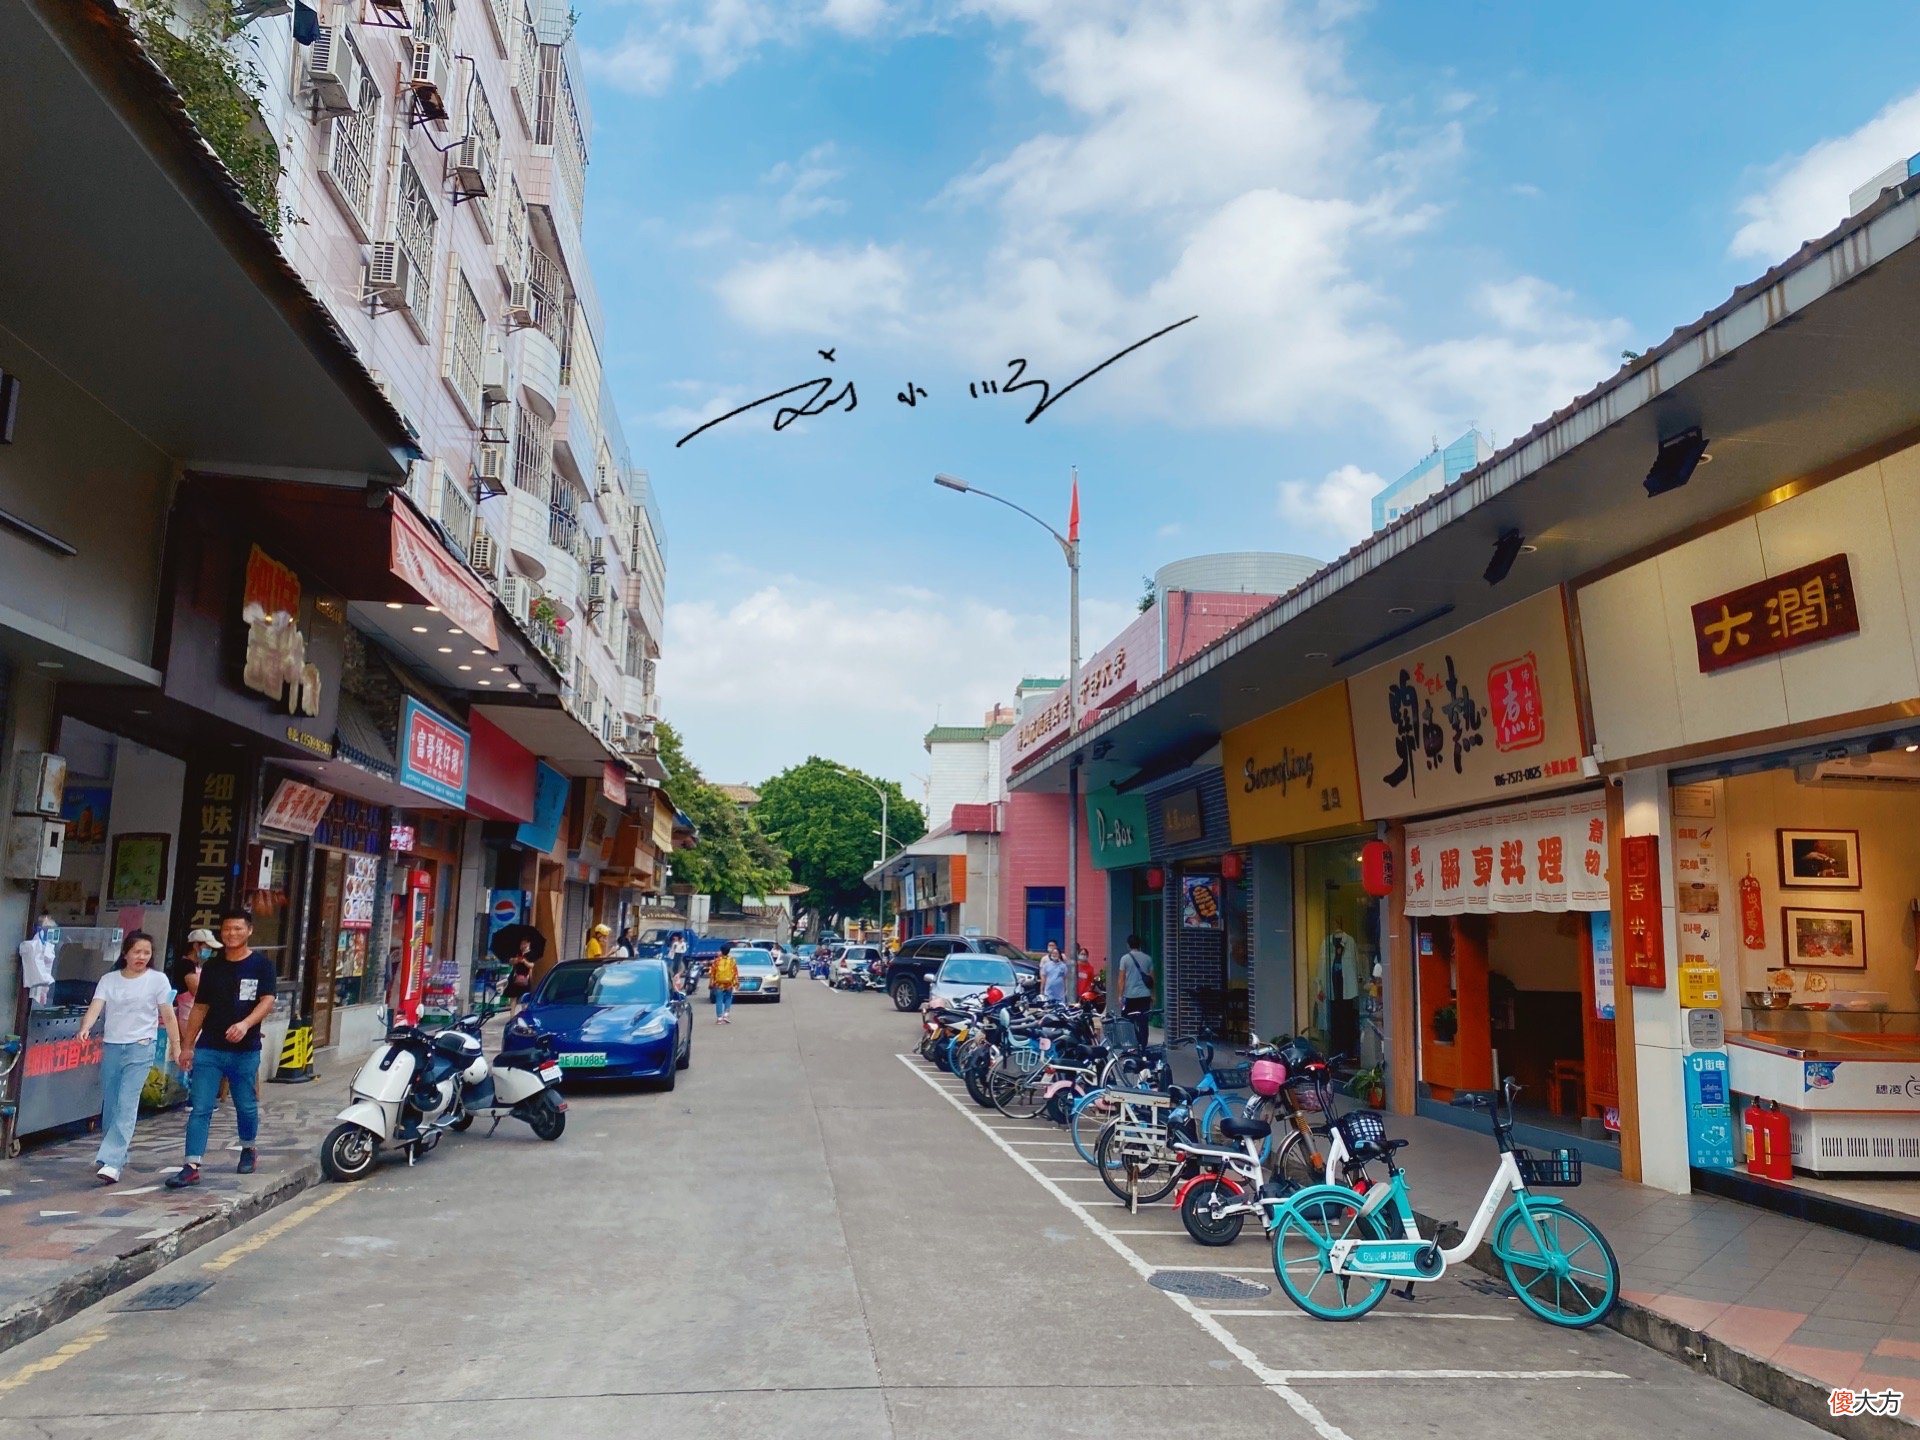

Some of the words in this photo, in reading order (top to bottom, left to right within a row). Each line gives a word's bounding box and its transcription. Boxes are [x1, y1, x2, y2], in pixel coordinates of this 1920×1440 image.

[1439, 835, 1564, 891] 關東料理
[1704, 1058, 1726, 1071] 街电
